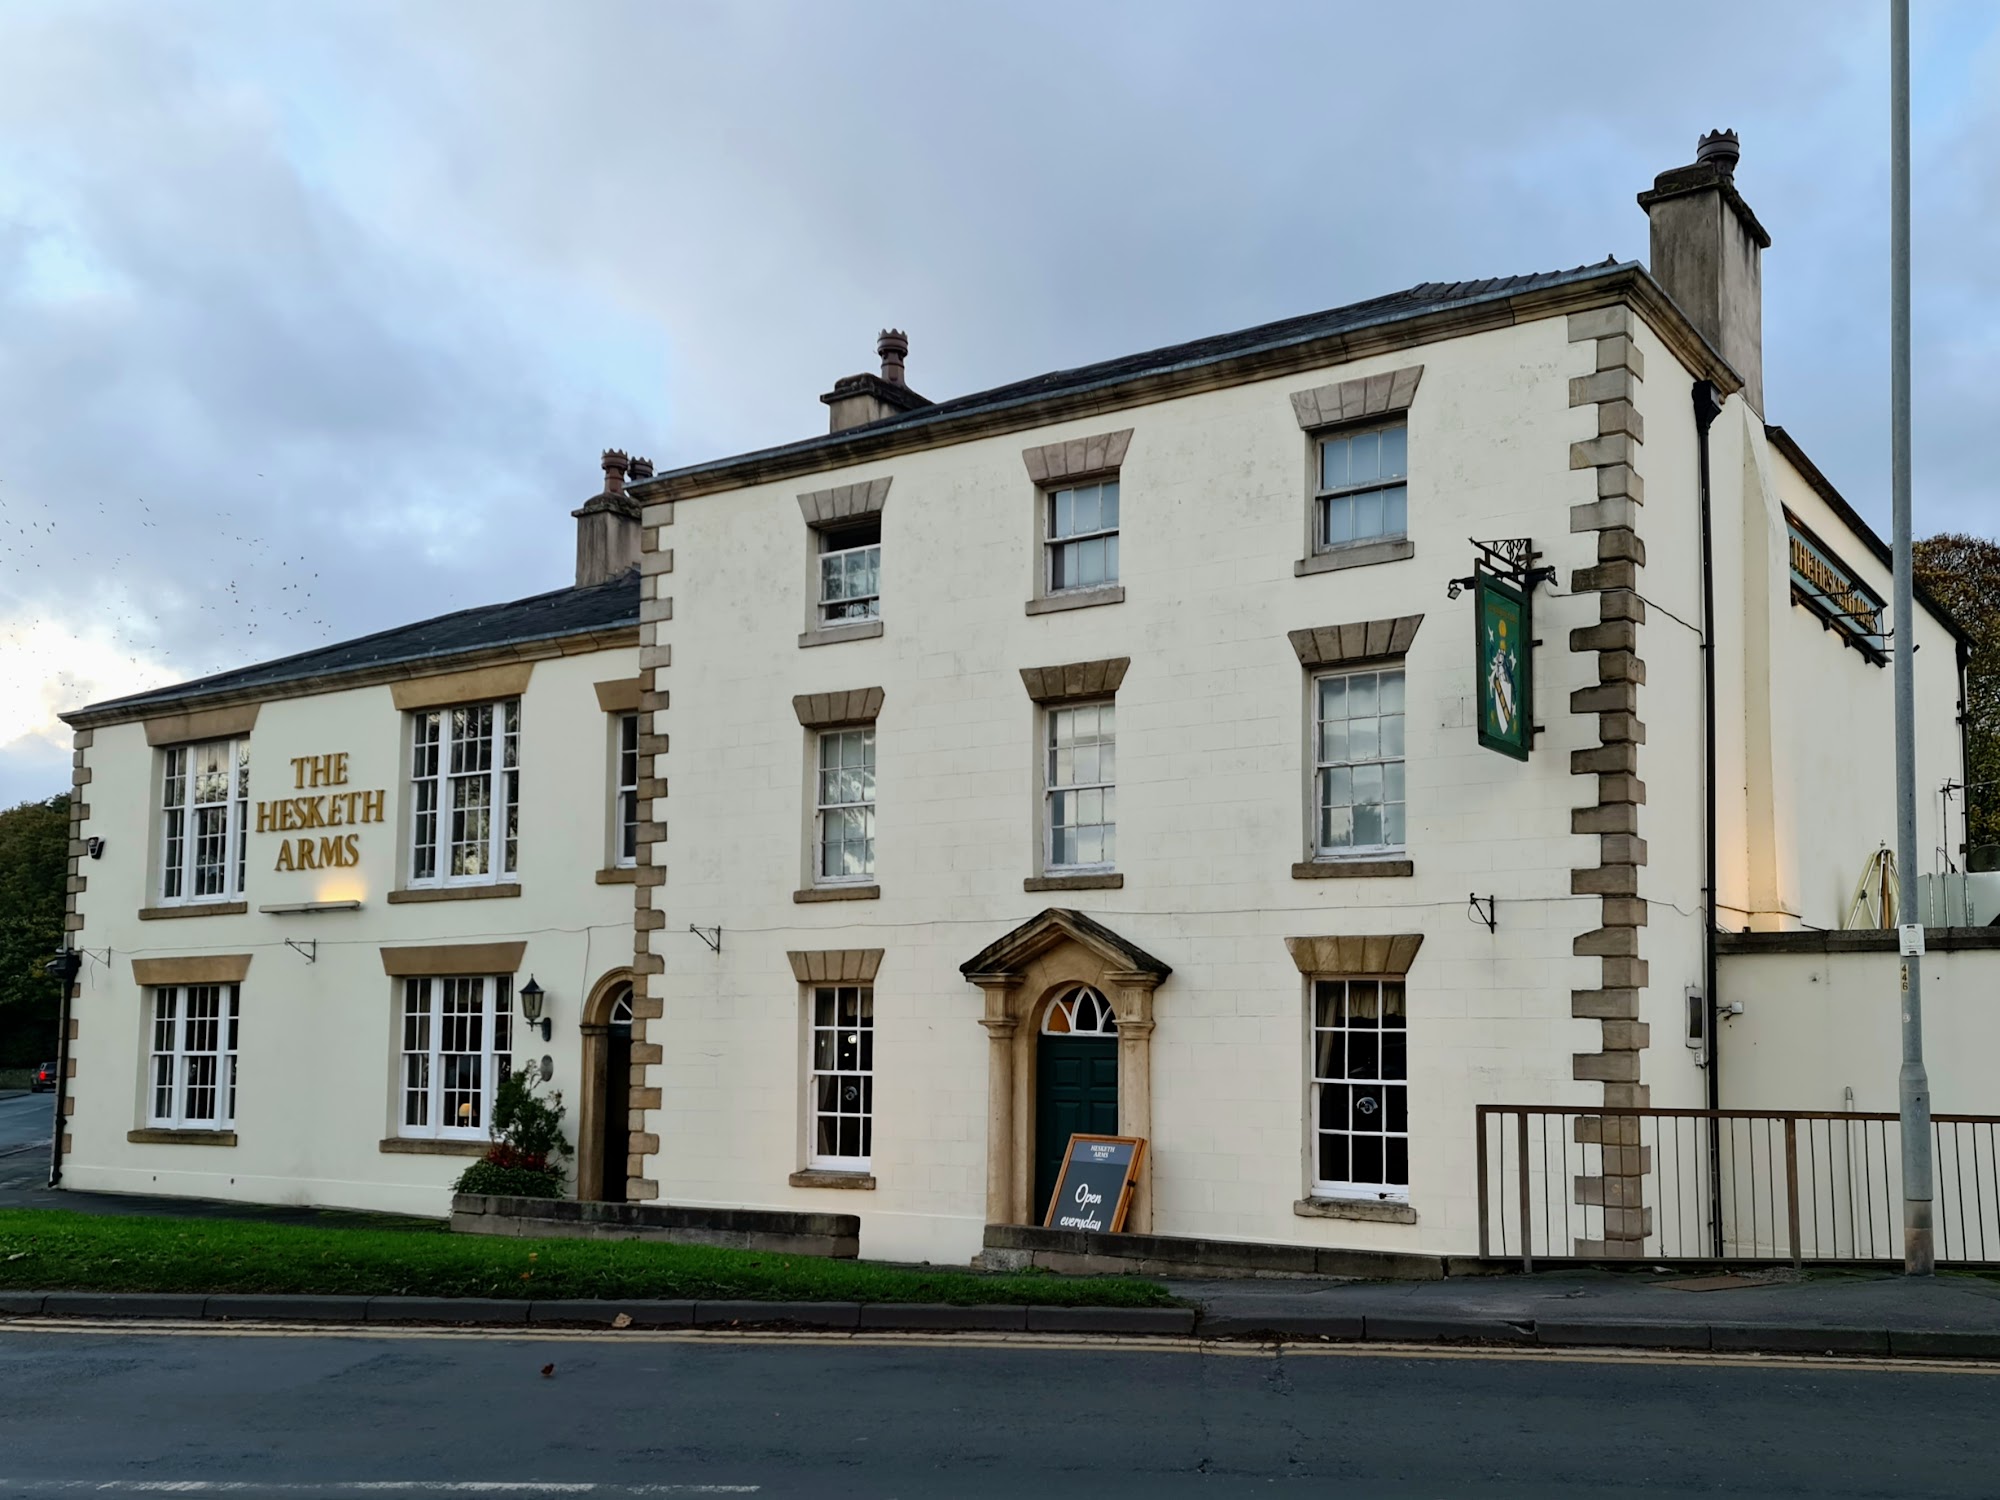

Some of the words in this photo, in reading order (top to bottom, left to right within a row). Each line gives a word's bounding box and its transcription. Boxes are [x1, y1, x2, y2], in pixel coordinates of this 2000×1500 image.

[1789, 536, 1816, 580] THE
[290, 752, 349, 789] THE
[255, 789, 386, 833] HESKETH
[274, 833, 360, 871] ARMS
[1901, 964, 1909, 991] 446
[1090, 1145, 1116, 1153] HESKETH
[1075, 1183, 1102, 1211] Open
[1060, 1210, 1102, 1231] everyday
